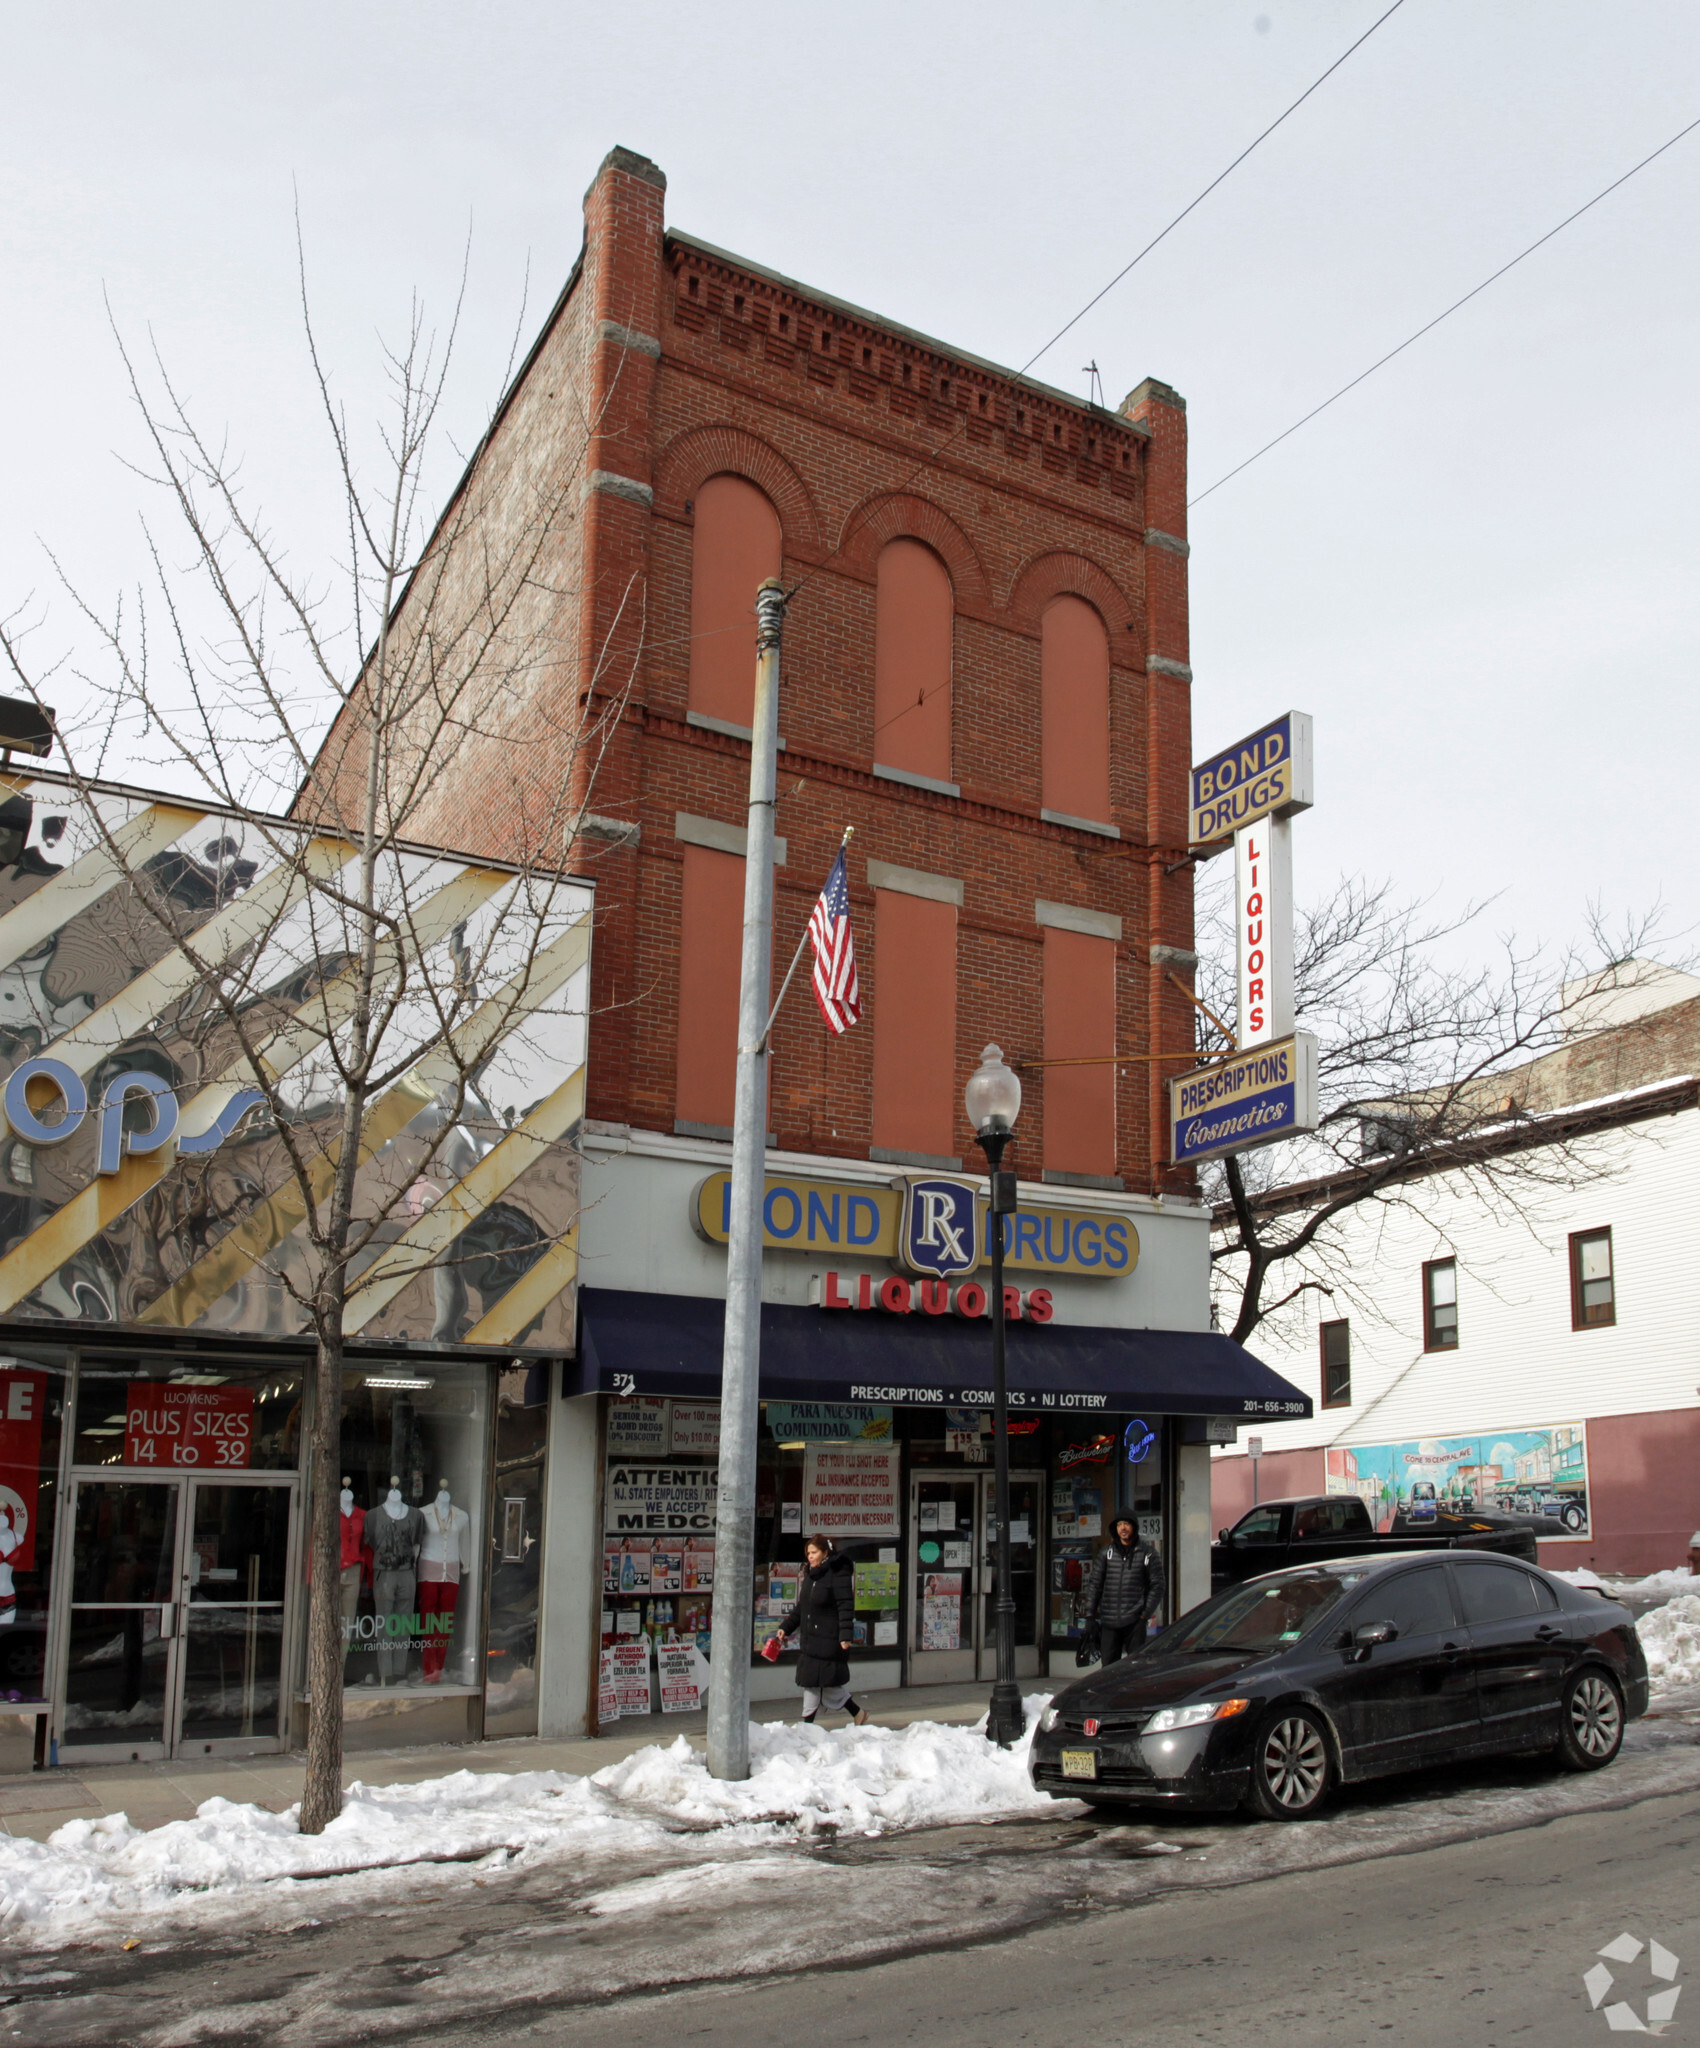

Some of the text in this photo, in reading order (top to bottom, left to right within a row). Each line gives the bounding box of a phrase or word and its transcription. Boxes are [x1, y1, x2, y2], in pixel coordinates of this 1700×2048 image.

[1199, 733, 1285, 803] BOND
[1199, 768, 1284, 838] DRUGS
[1247, 838, 1264, 1032] LIQUORS
[1181, 1051, 1288, 1117] PRESCRIPTIONS
[1185, 1100, 1288, 1149] Cosmetics
[722, 1181, 881, 1246] OND
[984, 1206, 1129, 1269] DRUGS
[821, 1271, 1054, 1323] LIQUORS
[612, 1373, 635, 1387] 371
[164, 1392, 219, 1405] WOMENS
[850, 1385, 1108, 1408] PRESCRIPTIONS COSMICS NJ LOTTERY
[612, 1412, 658, 1422] SENIOR DAY
[674, 1409, 691, 1420] Over
[693, 1410, 705, 1421] 100
[790, 1404, 875, 1421] PARA NUESTRA
[128, 1408, 249, 1437] PLUS SIZES
[616, 1422, 637, 1431] BOND
[638, 1423, 664, 1432] DRUGS
[625, 1432, 662, 1442] DISCOUNT
[674, 1431, 689, 1444] Only
[691, 1432, 712, 1443] $10.00
[131, 1438, 245, 1465] 14 to 32
[1431, 1453, 1458, 1463] CENTRAL
[1459, 1447, 1471, 1458] AVE
[817, 1454, 889, 1468] GET YOUR FLU SHOT HERE
[815, 1473, 890, 1487] ALL INSURANCE ACCEPTED
[628, 1487, 653, 1500] STATE
[655, 1487, 698, 1500] EMPLOYERS
[809, 1493, 894, 1506] NO APPOINTMENT NECESSARY
[645, 1501, 708, 1513] WE ACCEPT
[809, 1513, 895, 1526] NO PRESCRIPTION NECESSARY
[341, 1637, 455, 1653] ww.rainbowshops.com
[666, 1653, 688, 1661] NATURAL
[624, 1667, 637, 1675] FLOW
[660, 1660, 683, 1669] SUPERIOR
[666, 1667, 689, 1675] FORMULA
